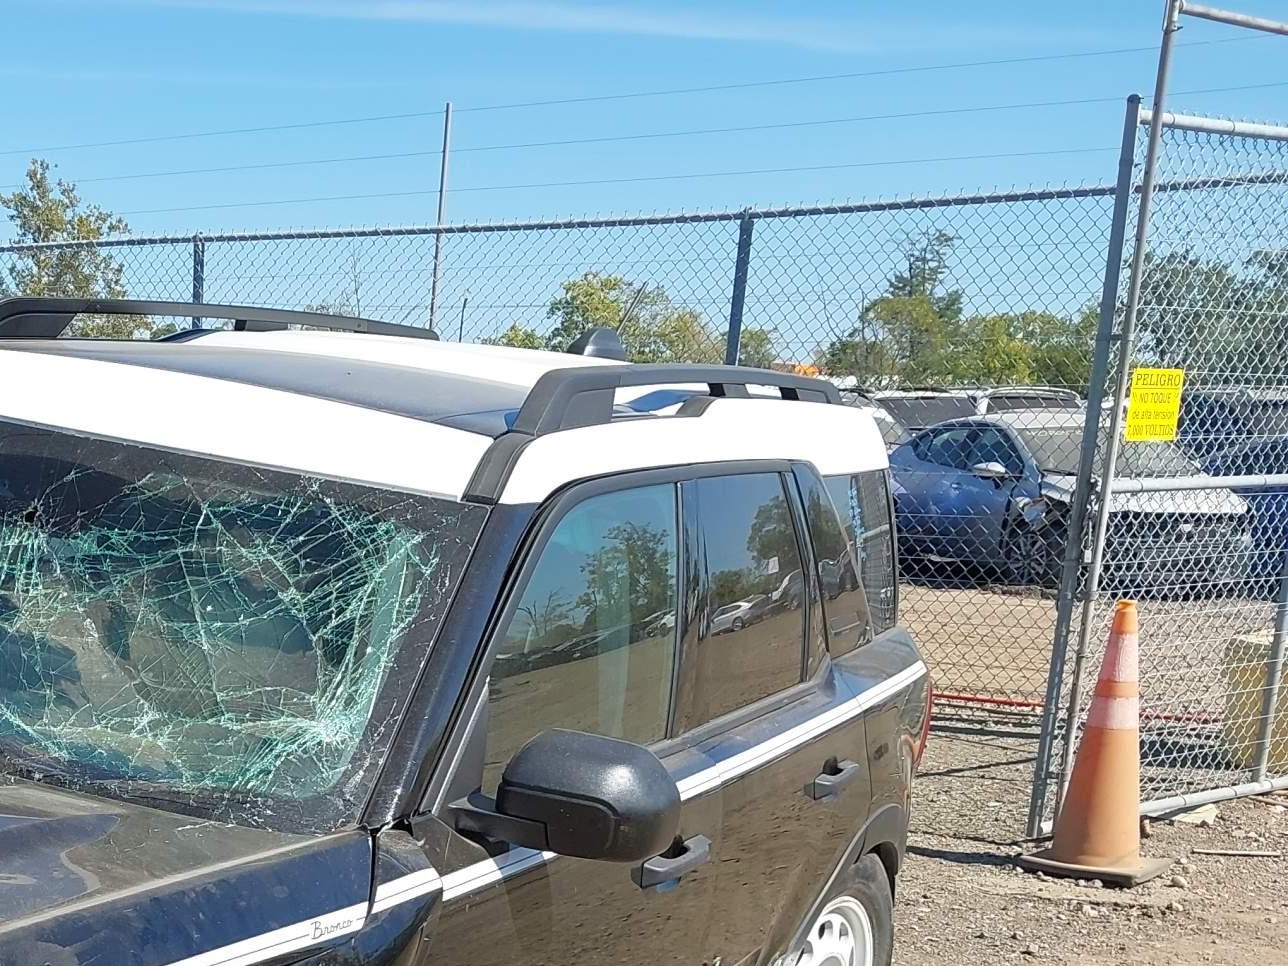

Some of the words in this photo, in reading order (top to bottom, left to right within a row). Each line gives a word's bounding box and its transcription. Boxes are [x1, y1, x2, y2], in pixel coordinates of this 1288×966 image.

[1135, 373, 1181, 386] PELIGRO
[1139, 392, 1149, 404] NO
[1151, 392, 1172, 404] TOQUE
[1145, 423, 1175, 436] VOLTIOS
[310, 920, 353, 939] Bronco
